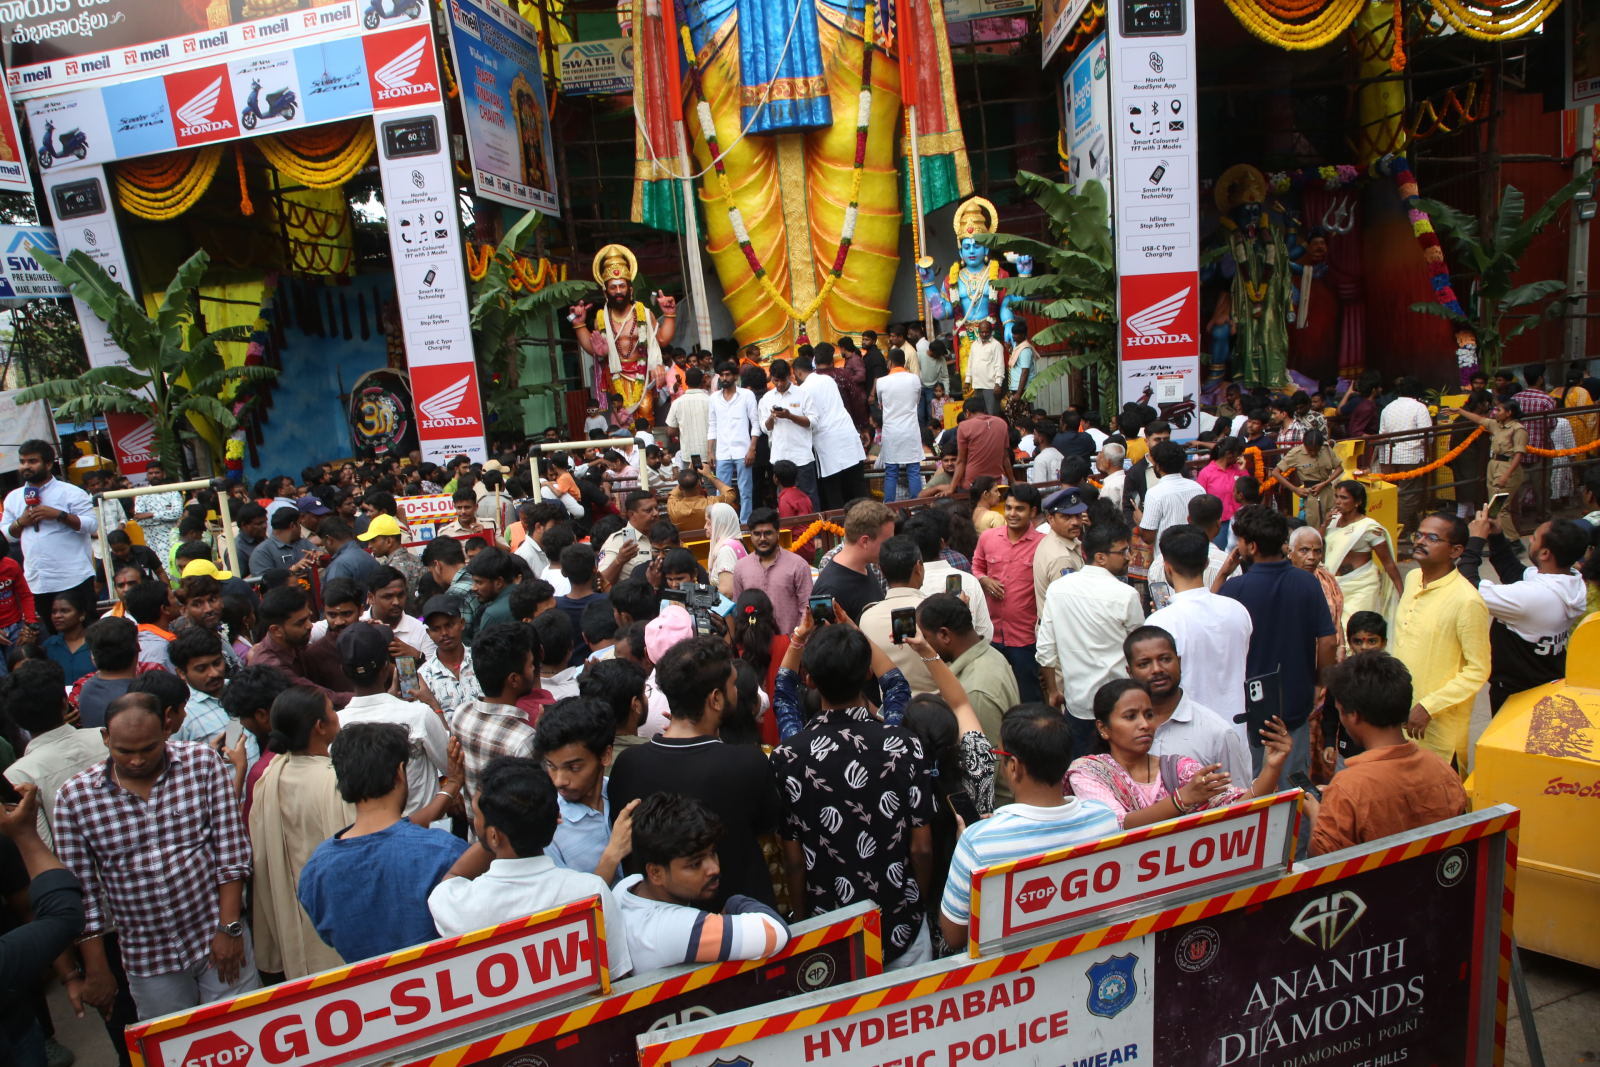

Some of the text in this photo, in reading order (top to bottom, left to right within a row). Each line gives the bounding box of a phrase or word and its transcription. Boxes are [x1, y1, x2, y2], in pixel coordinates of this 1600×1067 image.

[199, 31, 229, 51] meil
[140, 43, 170, 63] meil
[562, 56, 615, 69] SWATHI
[81, 55, 111, 73] meil
[23, 66, 52, 84] meil
[377, 82, 437, 101] HONDA
[181, 119, 233, 137] HONDA
[0, 165, 21, 176] meil
[1126, 333, 1193, 347] HONDA
[421, 416, 478, 429] HONDA
[1018, 825, 1256, 904] STOP GO SLOW
[1242, 937, 1409, 1017] ANANTH
[803, 975, 1036, 1063] HYDERABAD
[1216, 974, 1425, 1067] DIAMONDS
[948, 1010, 1069, 1067] POLICE
[1378, 1018, 1419, 1042] POLKI
